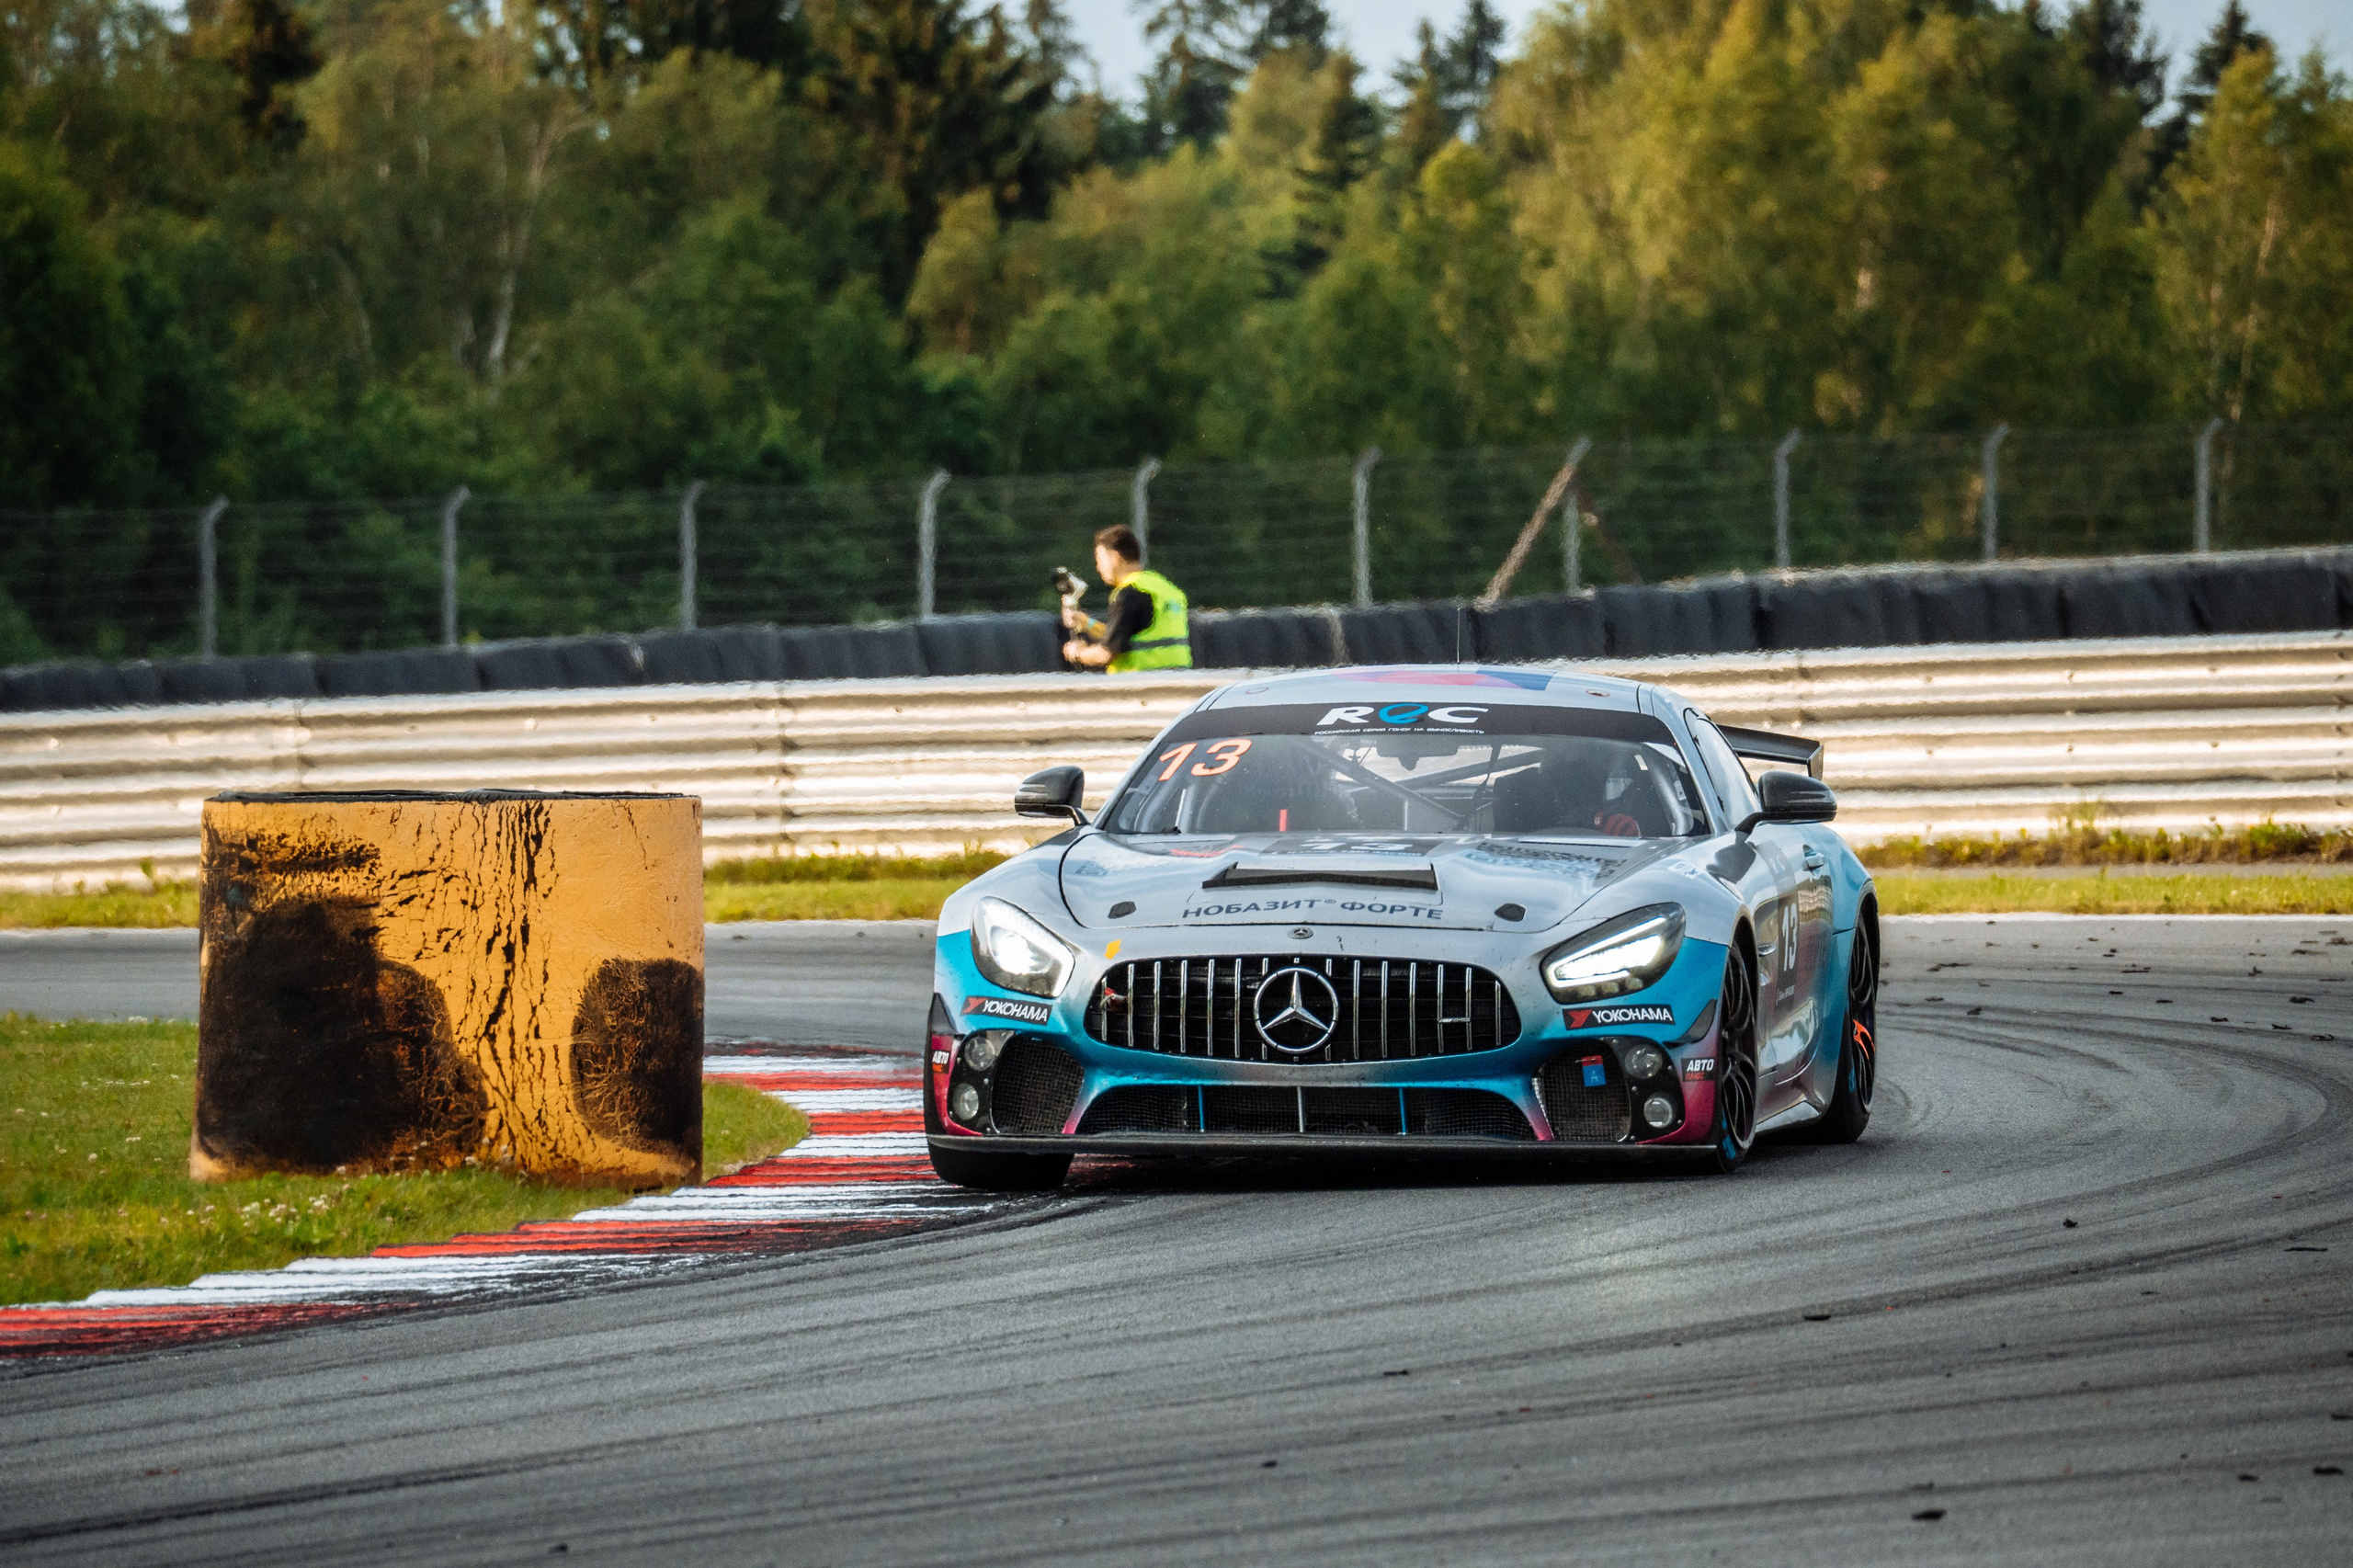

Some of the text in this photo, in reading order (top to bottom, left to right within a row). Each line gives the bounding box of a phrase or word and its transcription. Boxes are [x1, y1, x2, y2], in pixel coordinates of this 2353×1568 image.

[1158, 738, 1252, 781] 13
[1340, 901, 1444, 920] ФОРТЕ
[1782, 903, 1798, 971] 13
[983, 999, 1048, 1022] YOKOHAMA
[1592, 1007, 1673, 1024] YOKOHAMA
[1687, 1058, 1715, 1073] АВТО
